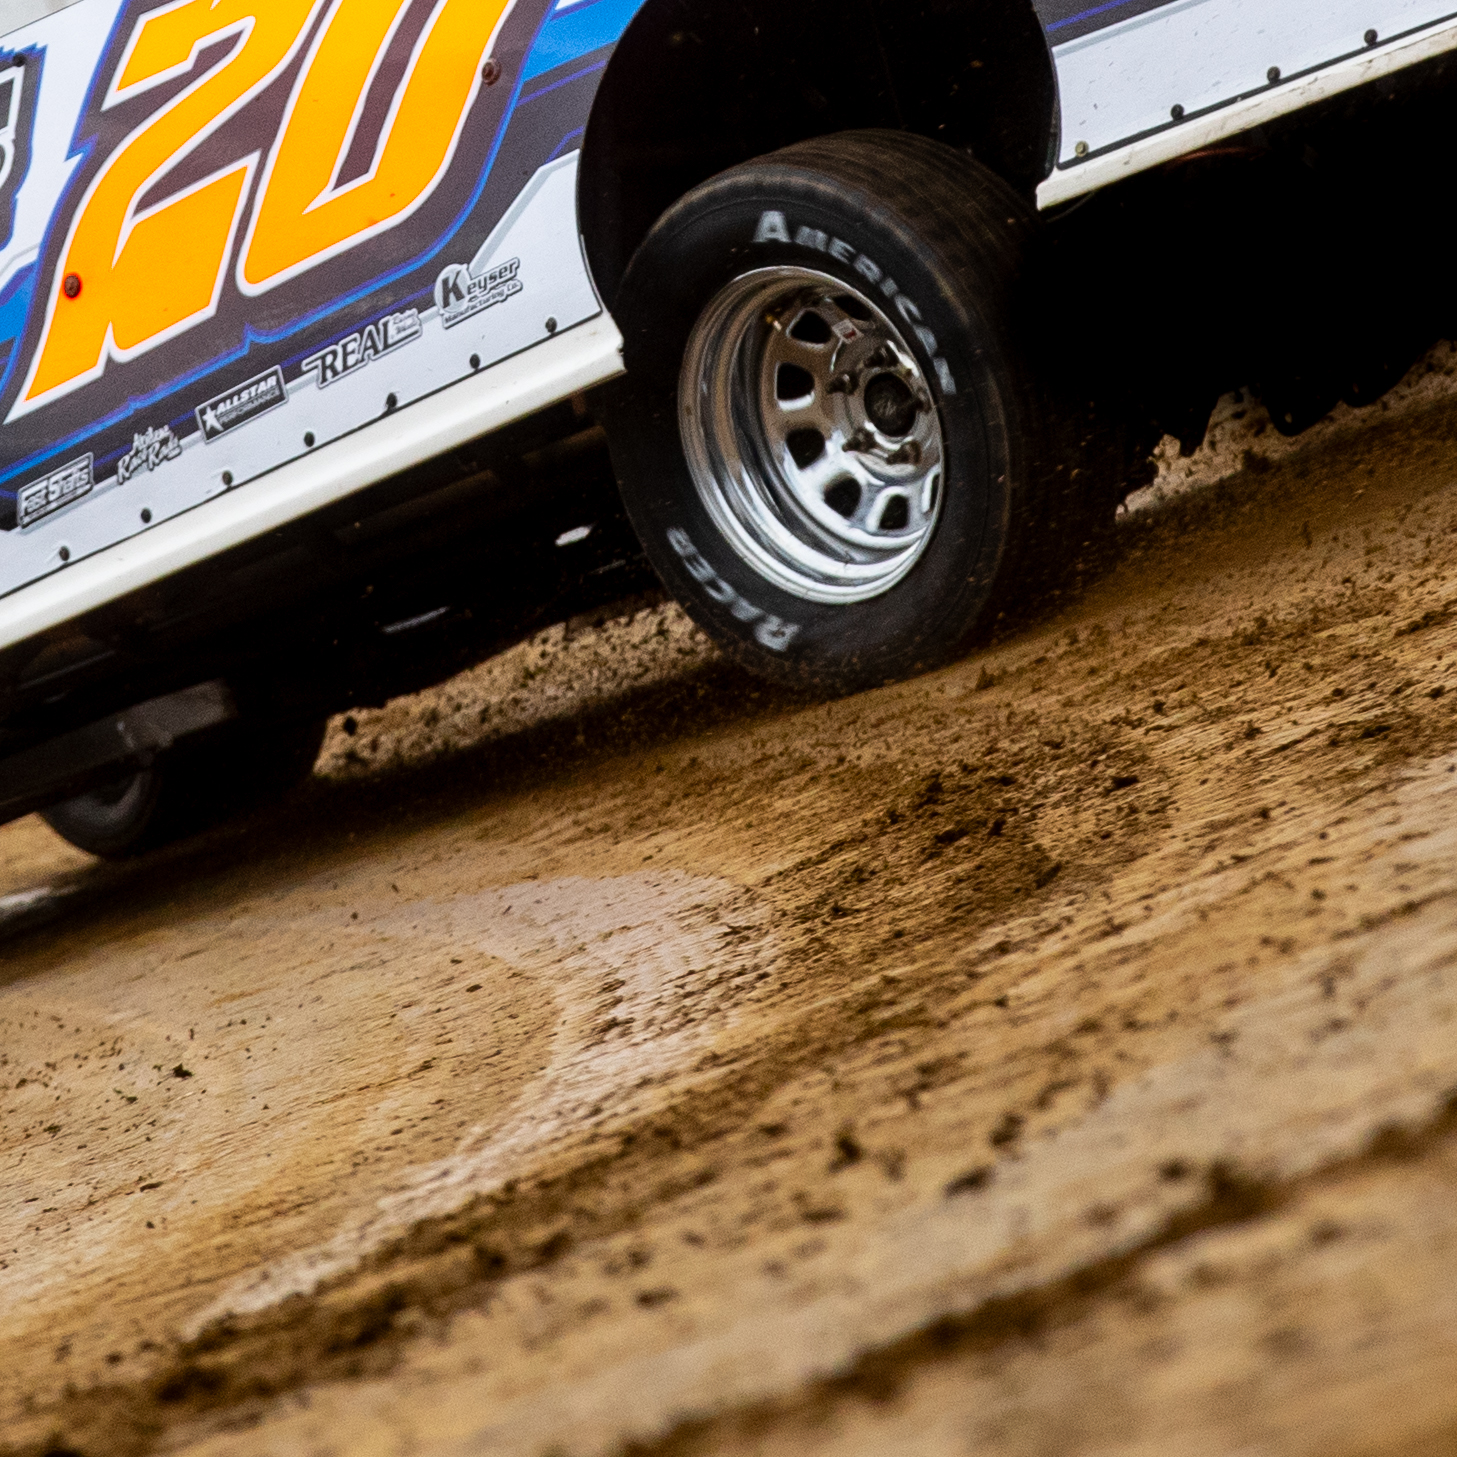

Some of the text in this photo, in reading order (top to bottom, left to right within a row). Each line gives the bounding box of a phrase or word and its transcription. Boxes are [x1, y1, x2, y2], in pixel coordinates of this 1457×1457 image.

[442, 261, 517, 309] Keyser
[305, 316, 406, 386] REAL
[216, 375, 278, 414] ALLSTAR
